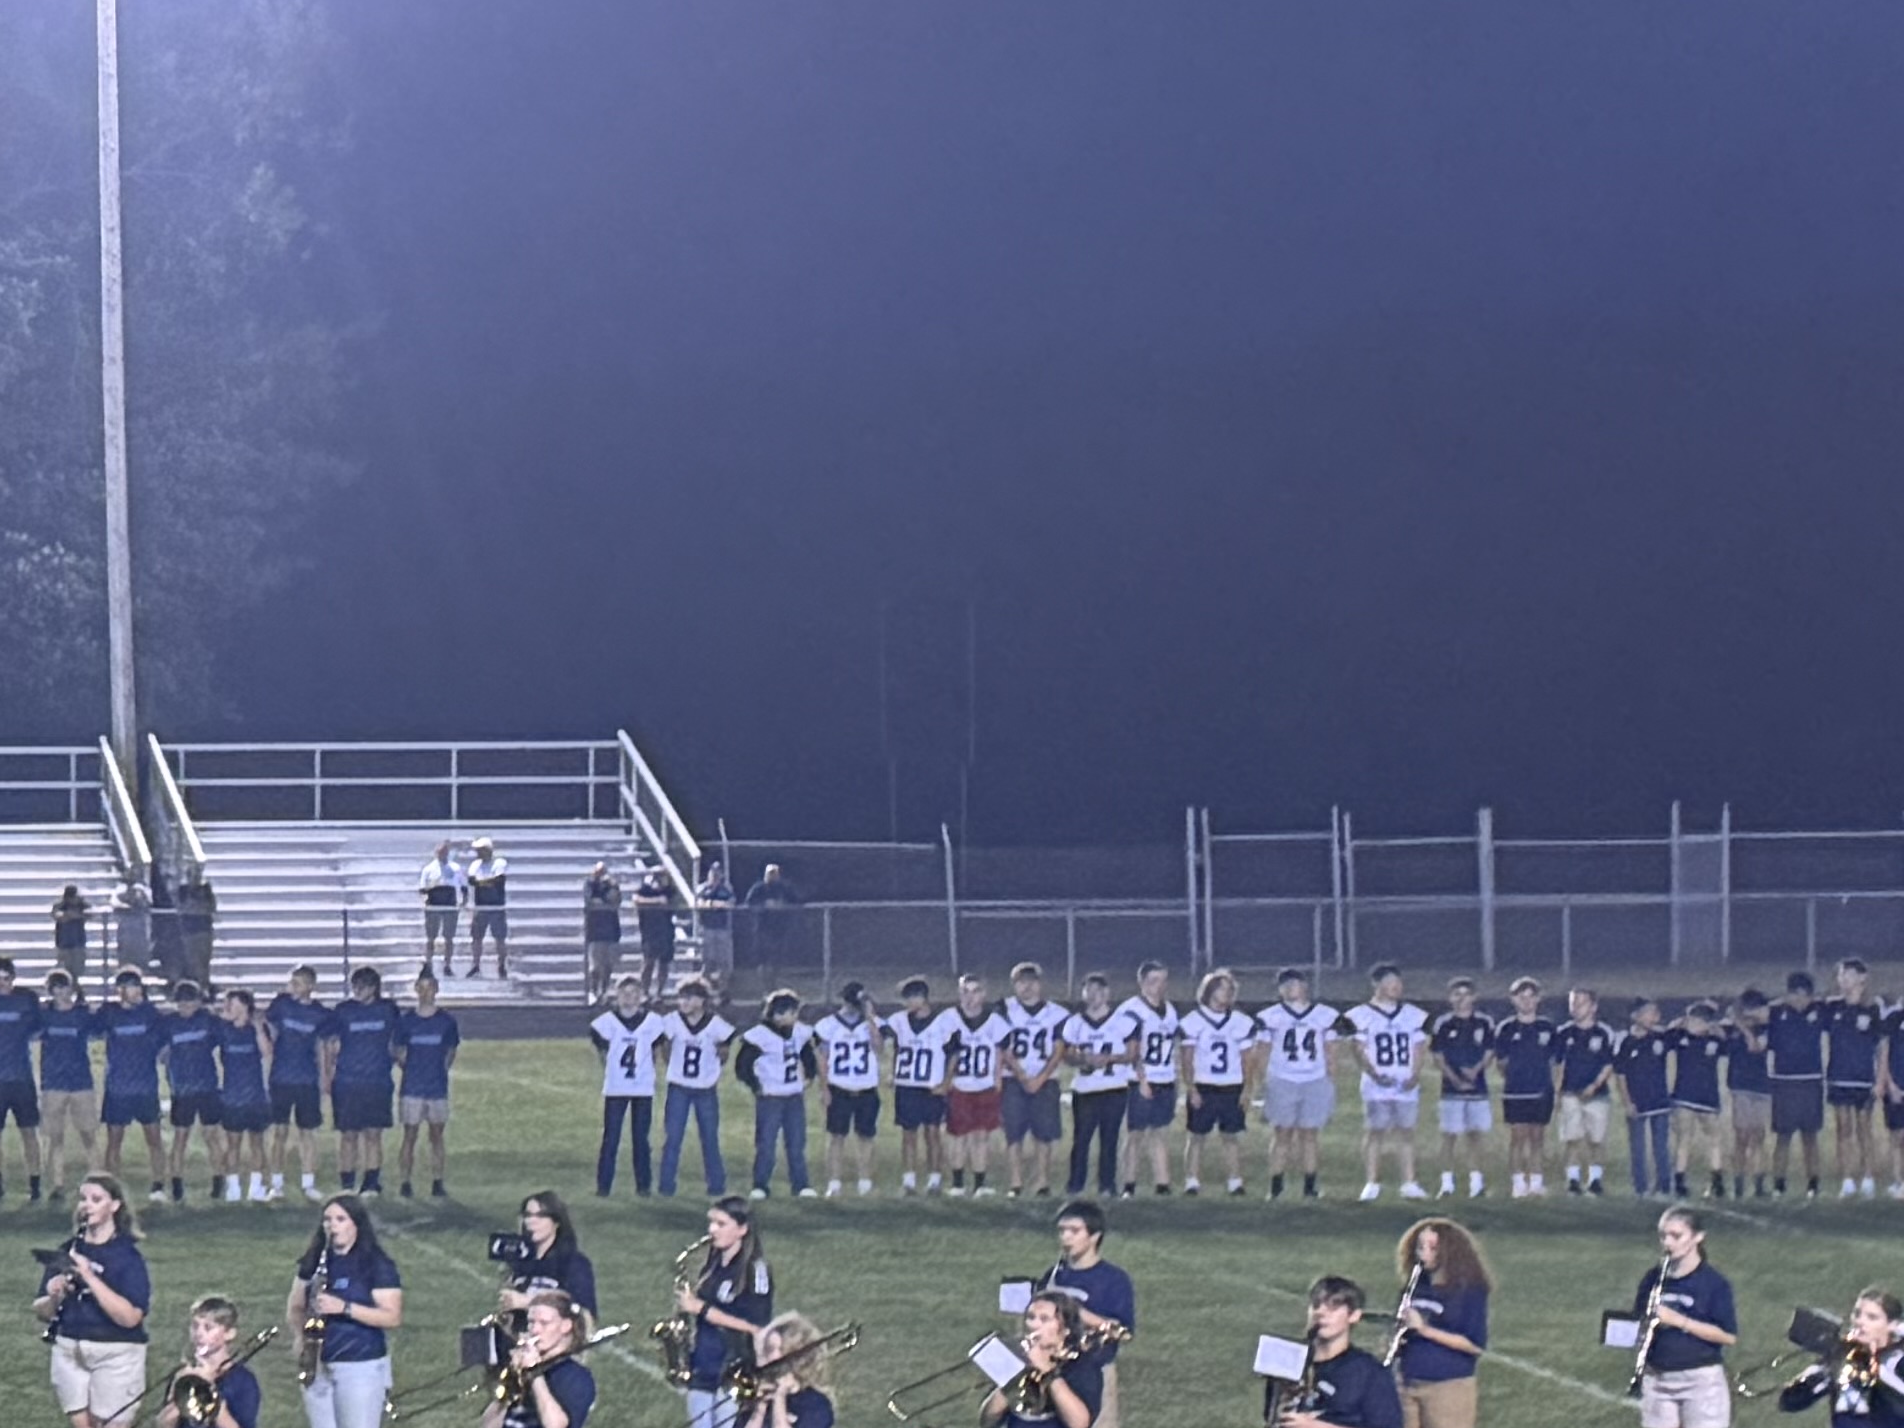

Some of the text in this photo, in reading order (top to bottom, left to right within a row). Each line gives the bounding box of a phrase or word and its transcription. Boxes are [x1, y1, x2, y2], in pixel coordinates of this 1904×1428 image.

[833, 1042, 870, 1076] 23
[1012, 1028, 1048, 1060] 64
[1145, 1032, 1176, 1066] 87
[1210, 1042, 1228, 1074] 3
[1282, 1028, 1317, 1062] 44
[1375, 1032, 1410, 1066] 88
[620, 1044, 637, 1079] 4
[683, 1046, 702, 1077] 8
[895, 1047, 933, 1081] 20
